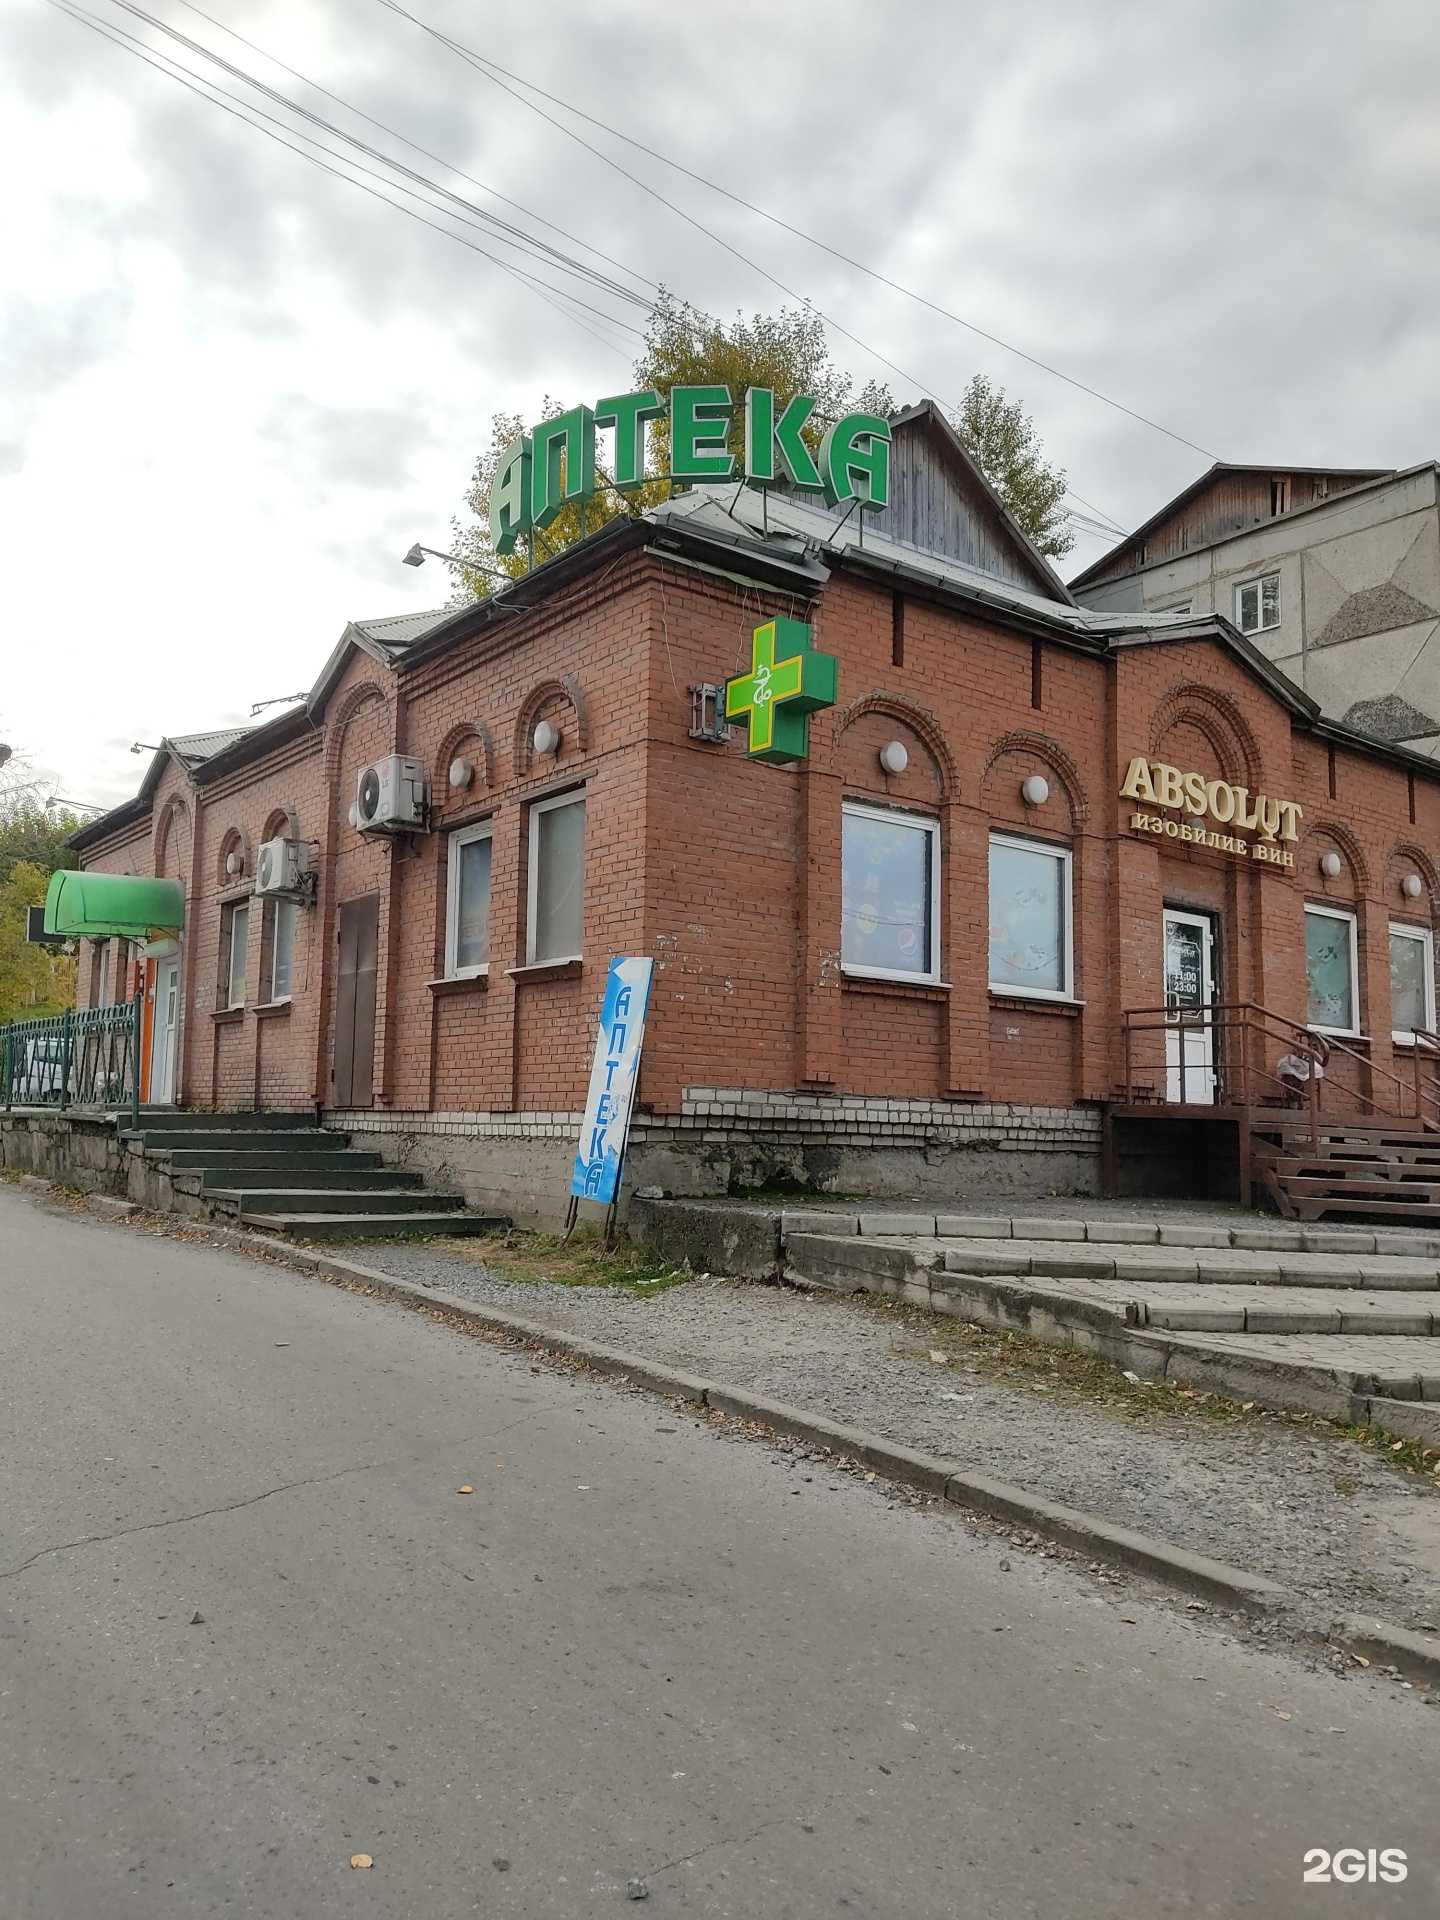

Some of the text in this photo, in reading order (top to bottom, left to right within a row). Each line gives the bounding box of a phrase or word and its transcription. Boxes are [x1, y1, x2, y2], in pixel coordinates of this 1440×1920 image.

[489, 384, 892, 554] АПТЕКА
[1119, 757, 1304, 842] ABSOLUT
[1130, 812, 1295, 867] ИЗОБИЛИЕ ВИН
[1173, 981, 1197, 994] 23:00
[584, 985, 632, 1197] АПТЕКА
